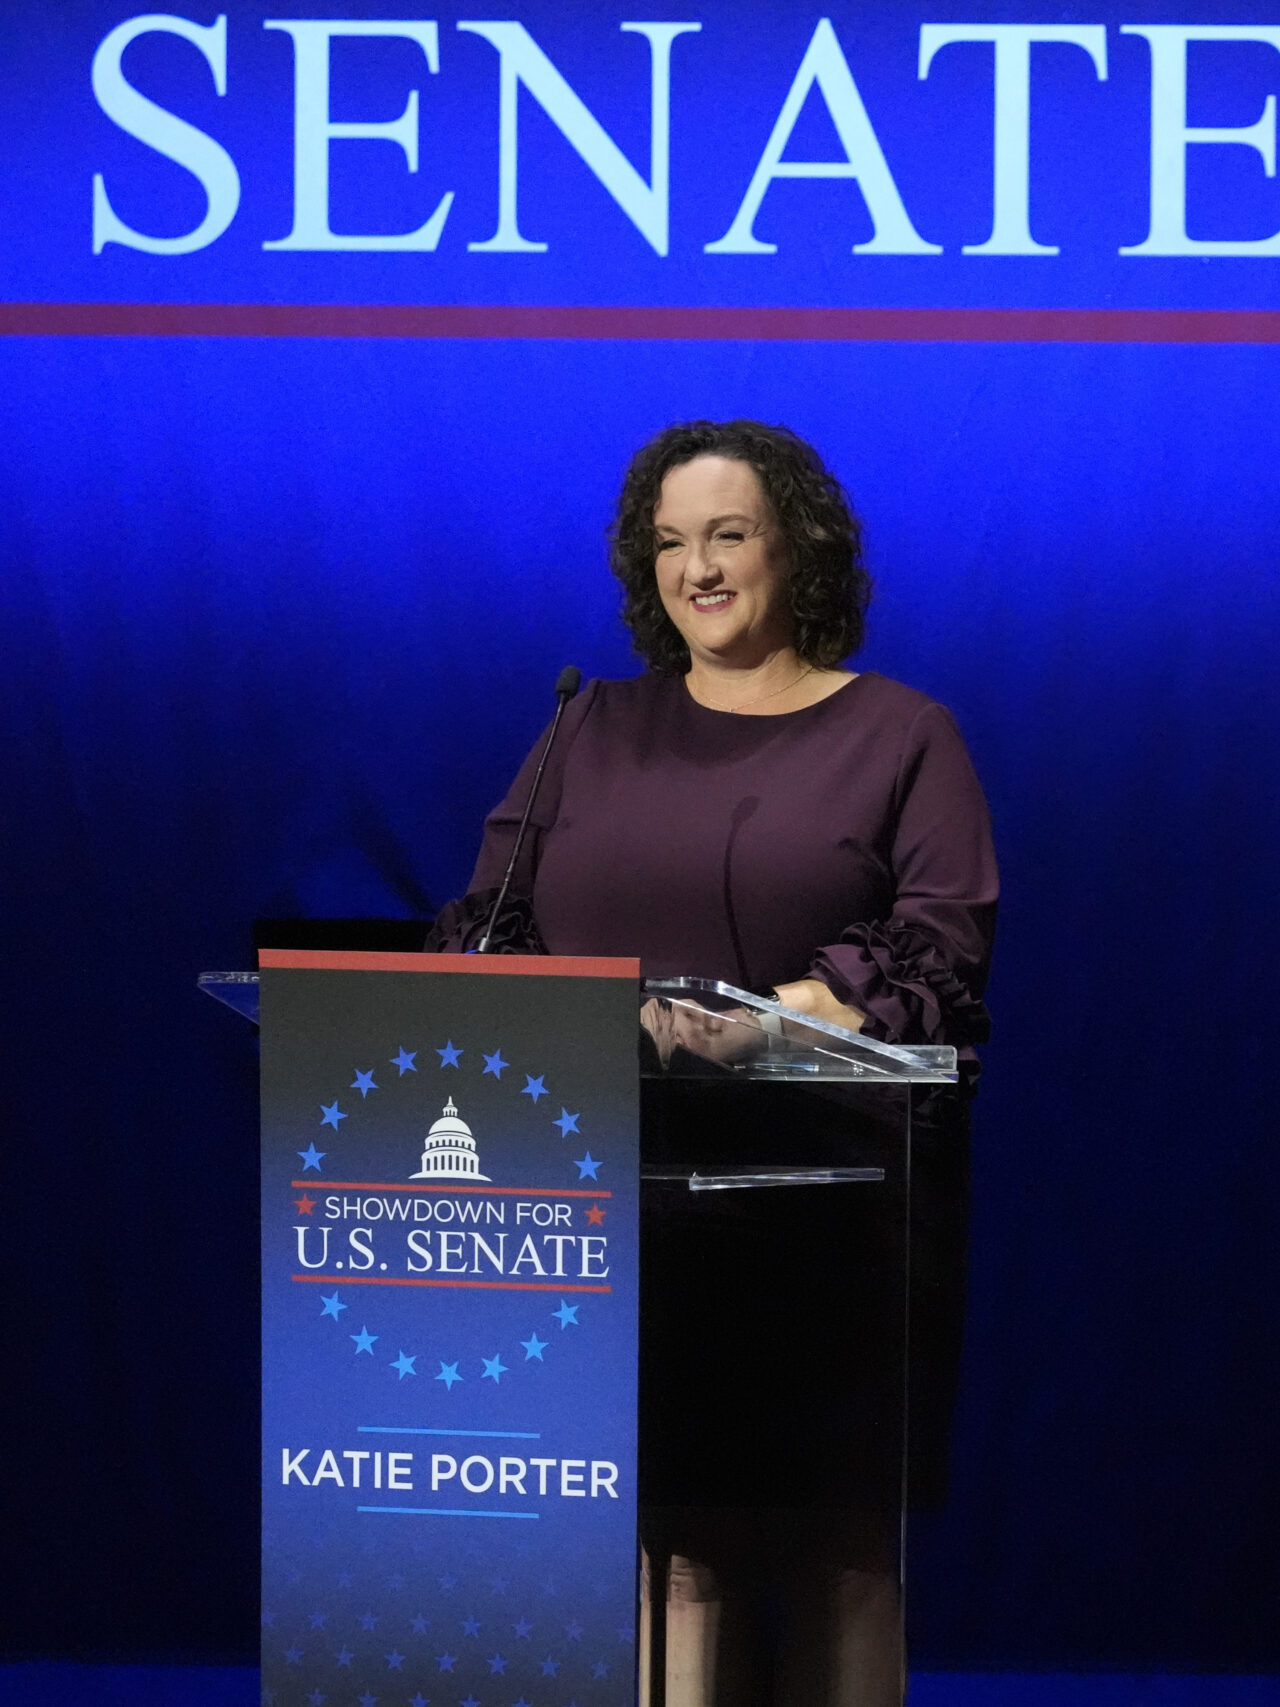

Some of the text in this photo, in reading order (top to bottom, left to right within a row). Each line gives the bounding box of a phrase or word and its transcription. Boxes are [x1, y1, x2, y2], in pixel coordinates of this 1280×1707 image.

[324, 1195, 572, 1228] SHOWDOWN FOR
[292, 1225, 610, 1279] U.S. SENATE
[282, 1447, 619, 1499] KATIE PORTER
